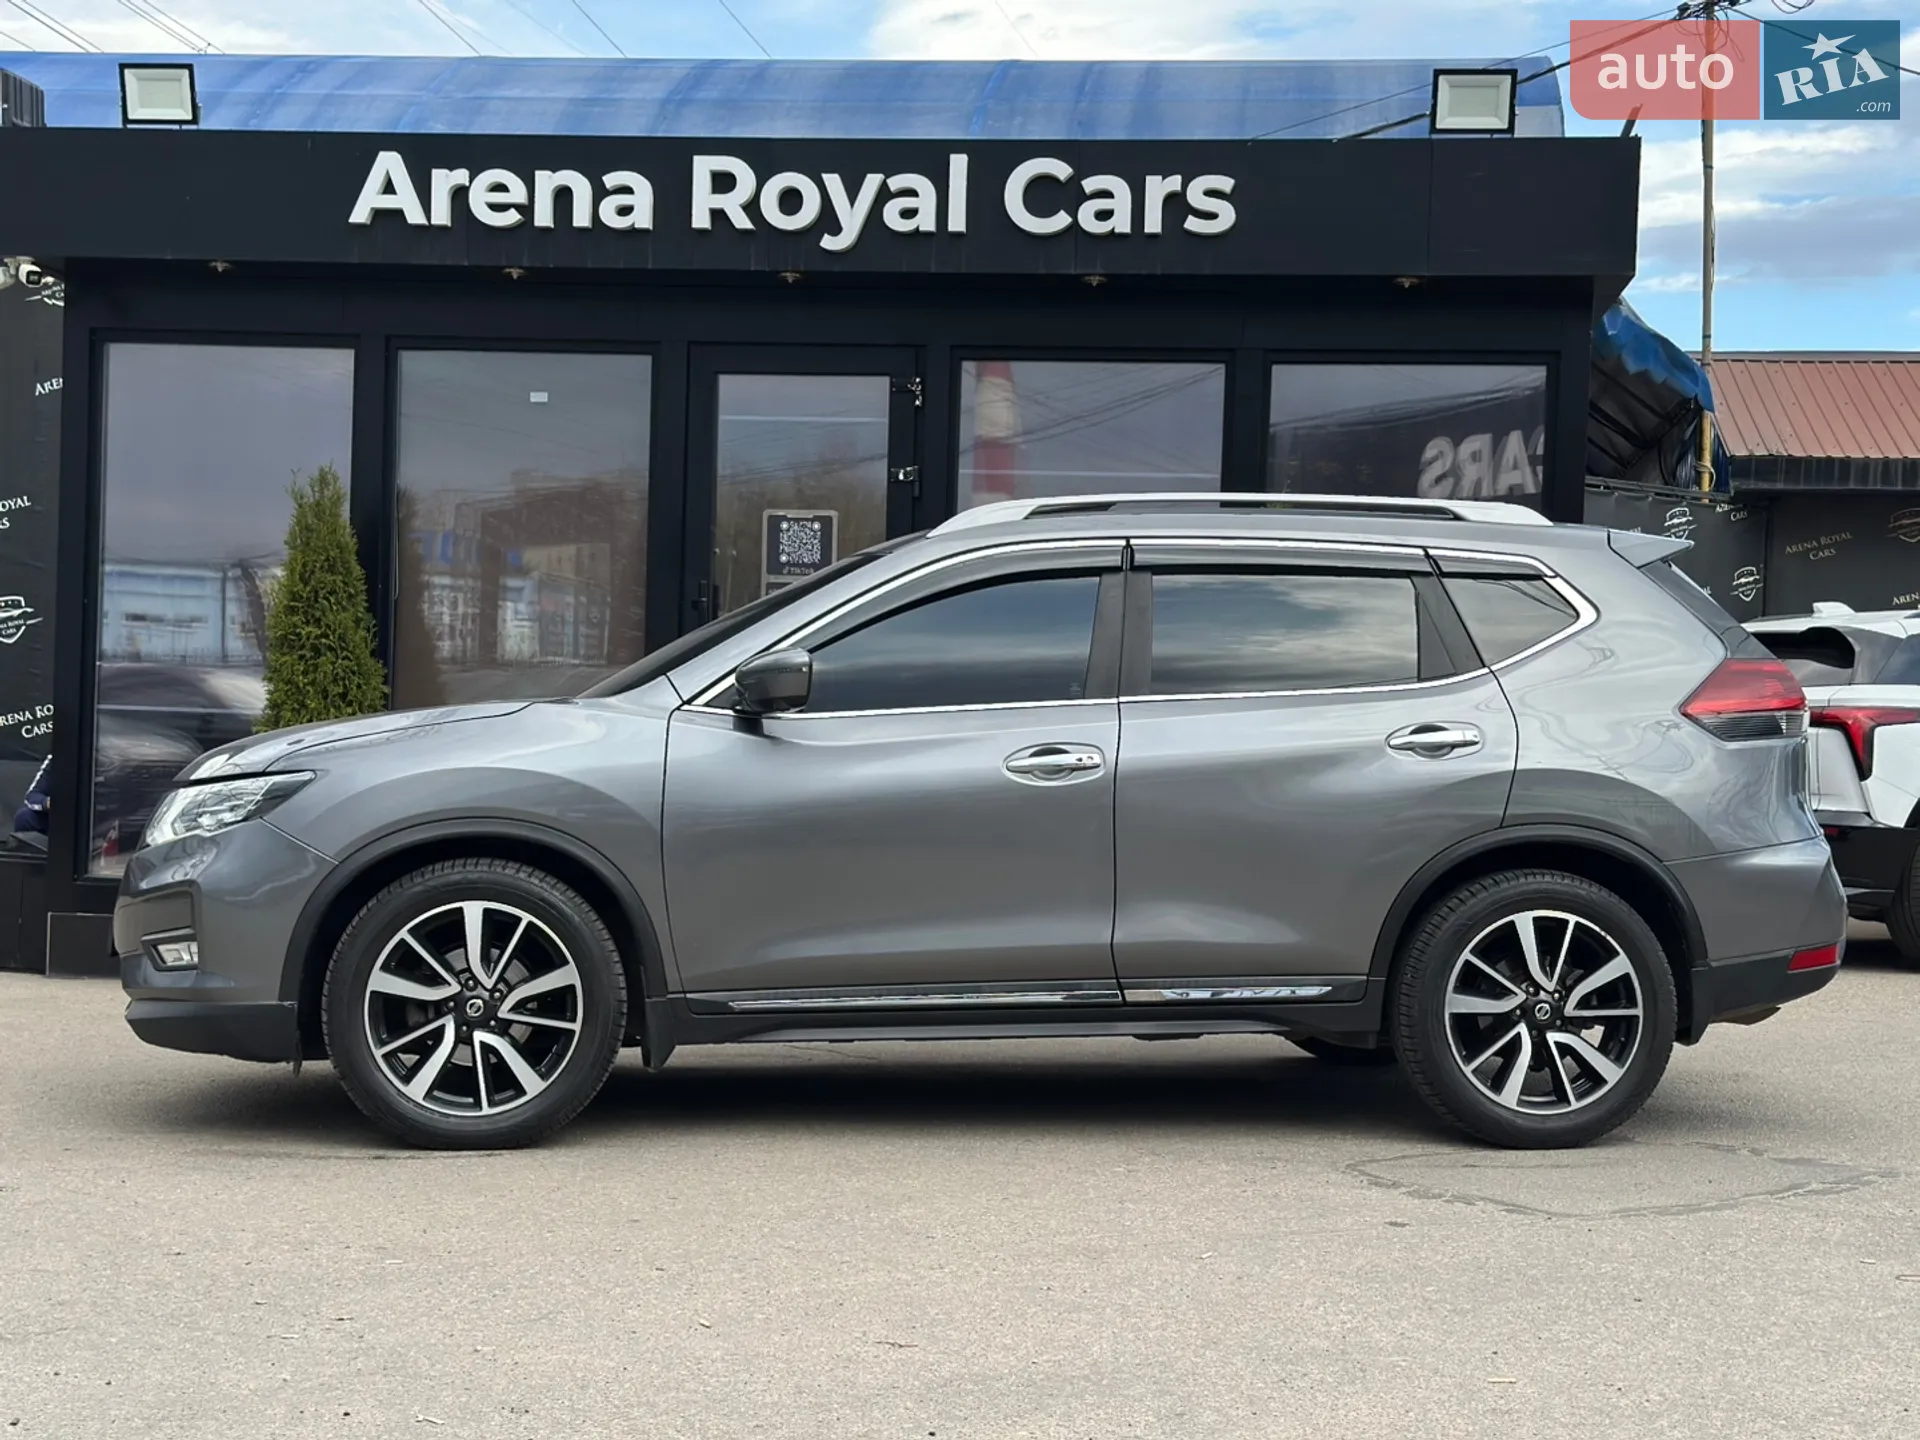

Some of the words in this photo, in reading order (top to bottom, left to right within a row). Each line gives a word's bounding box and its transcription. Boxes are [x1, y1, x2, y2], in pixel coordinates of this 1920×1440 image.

[348, 151, 653, 231] Arena
[692, 154, 968, 253] Royal
[1003, 158, 1237, 235] Cars
[1785, 540, 1819, 555] ARENA
[1820, 531, 1853, 546] ROYAL
[1809, 548, 1837, 561] CARS
[21, 721, 54, 738] CARS
